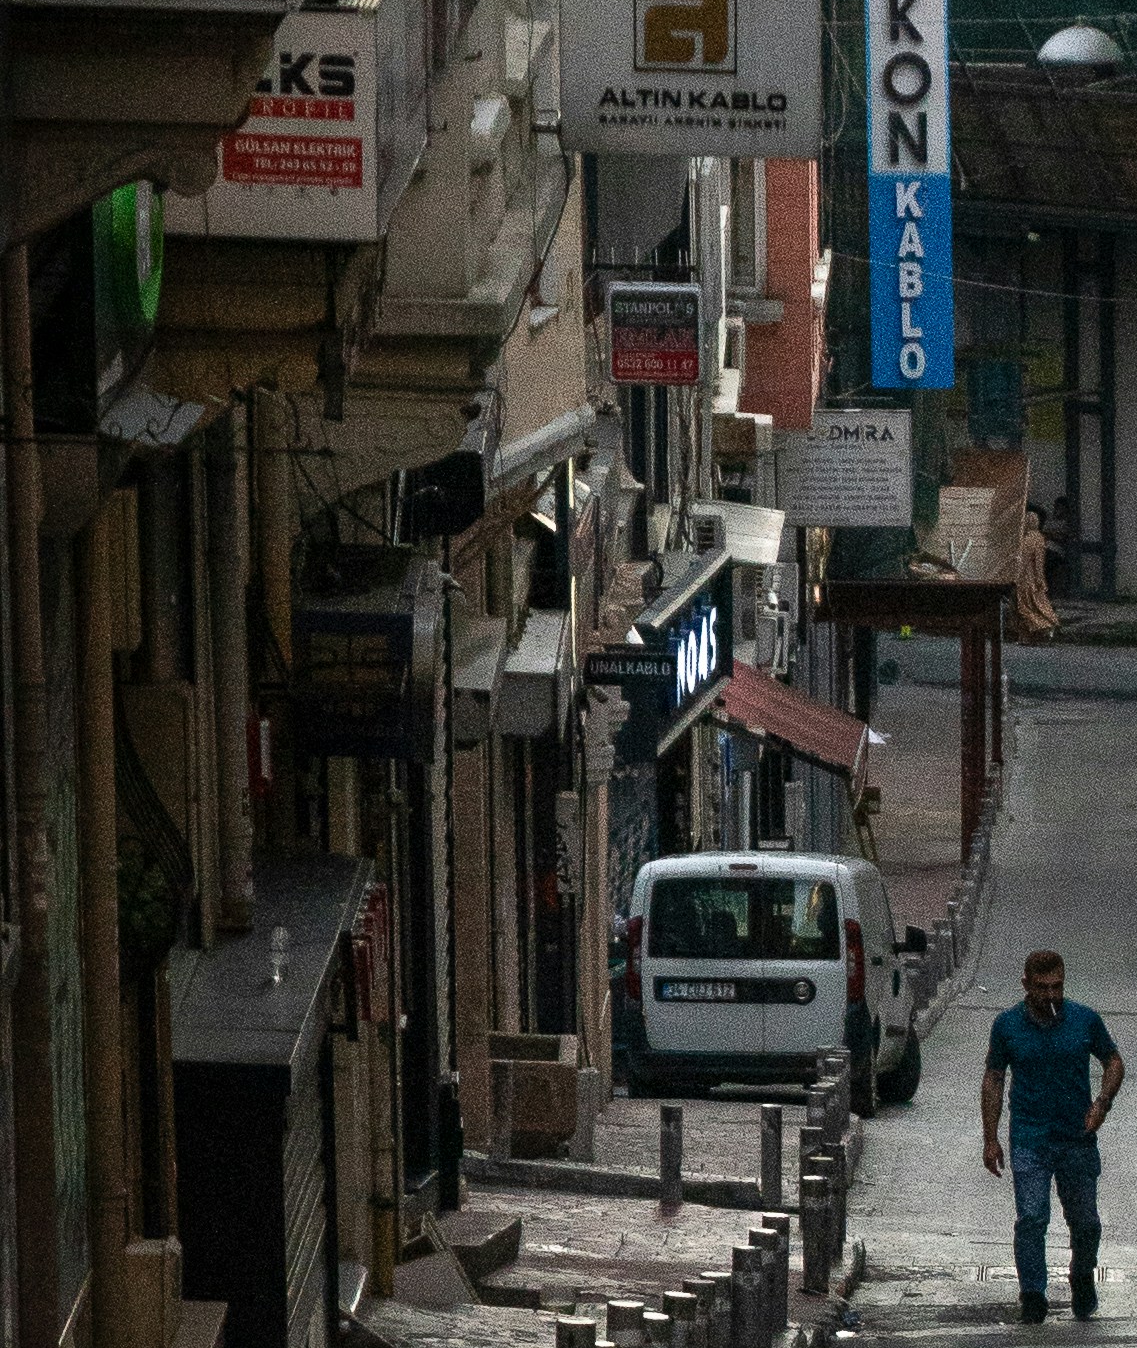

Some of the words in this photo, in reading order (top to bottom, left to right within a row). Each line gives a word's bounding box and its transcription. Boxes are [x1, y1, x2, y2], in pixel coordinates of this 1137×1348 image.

[255, 52, 355, 96] KS
[599, 87, 681, 108] ALTIN
[689, 92, 787, 112] KABLO
[895, 179, 928, 381] KABLO
